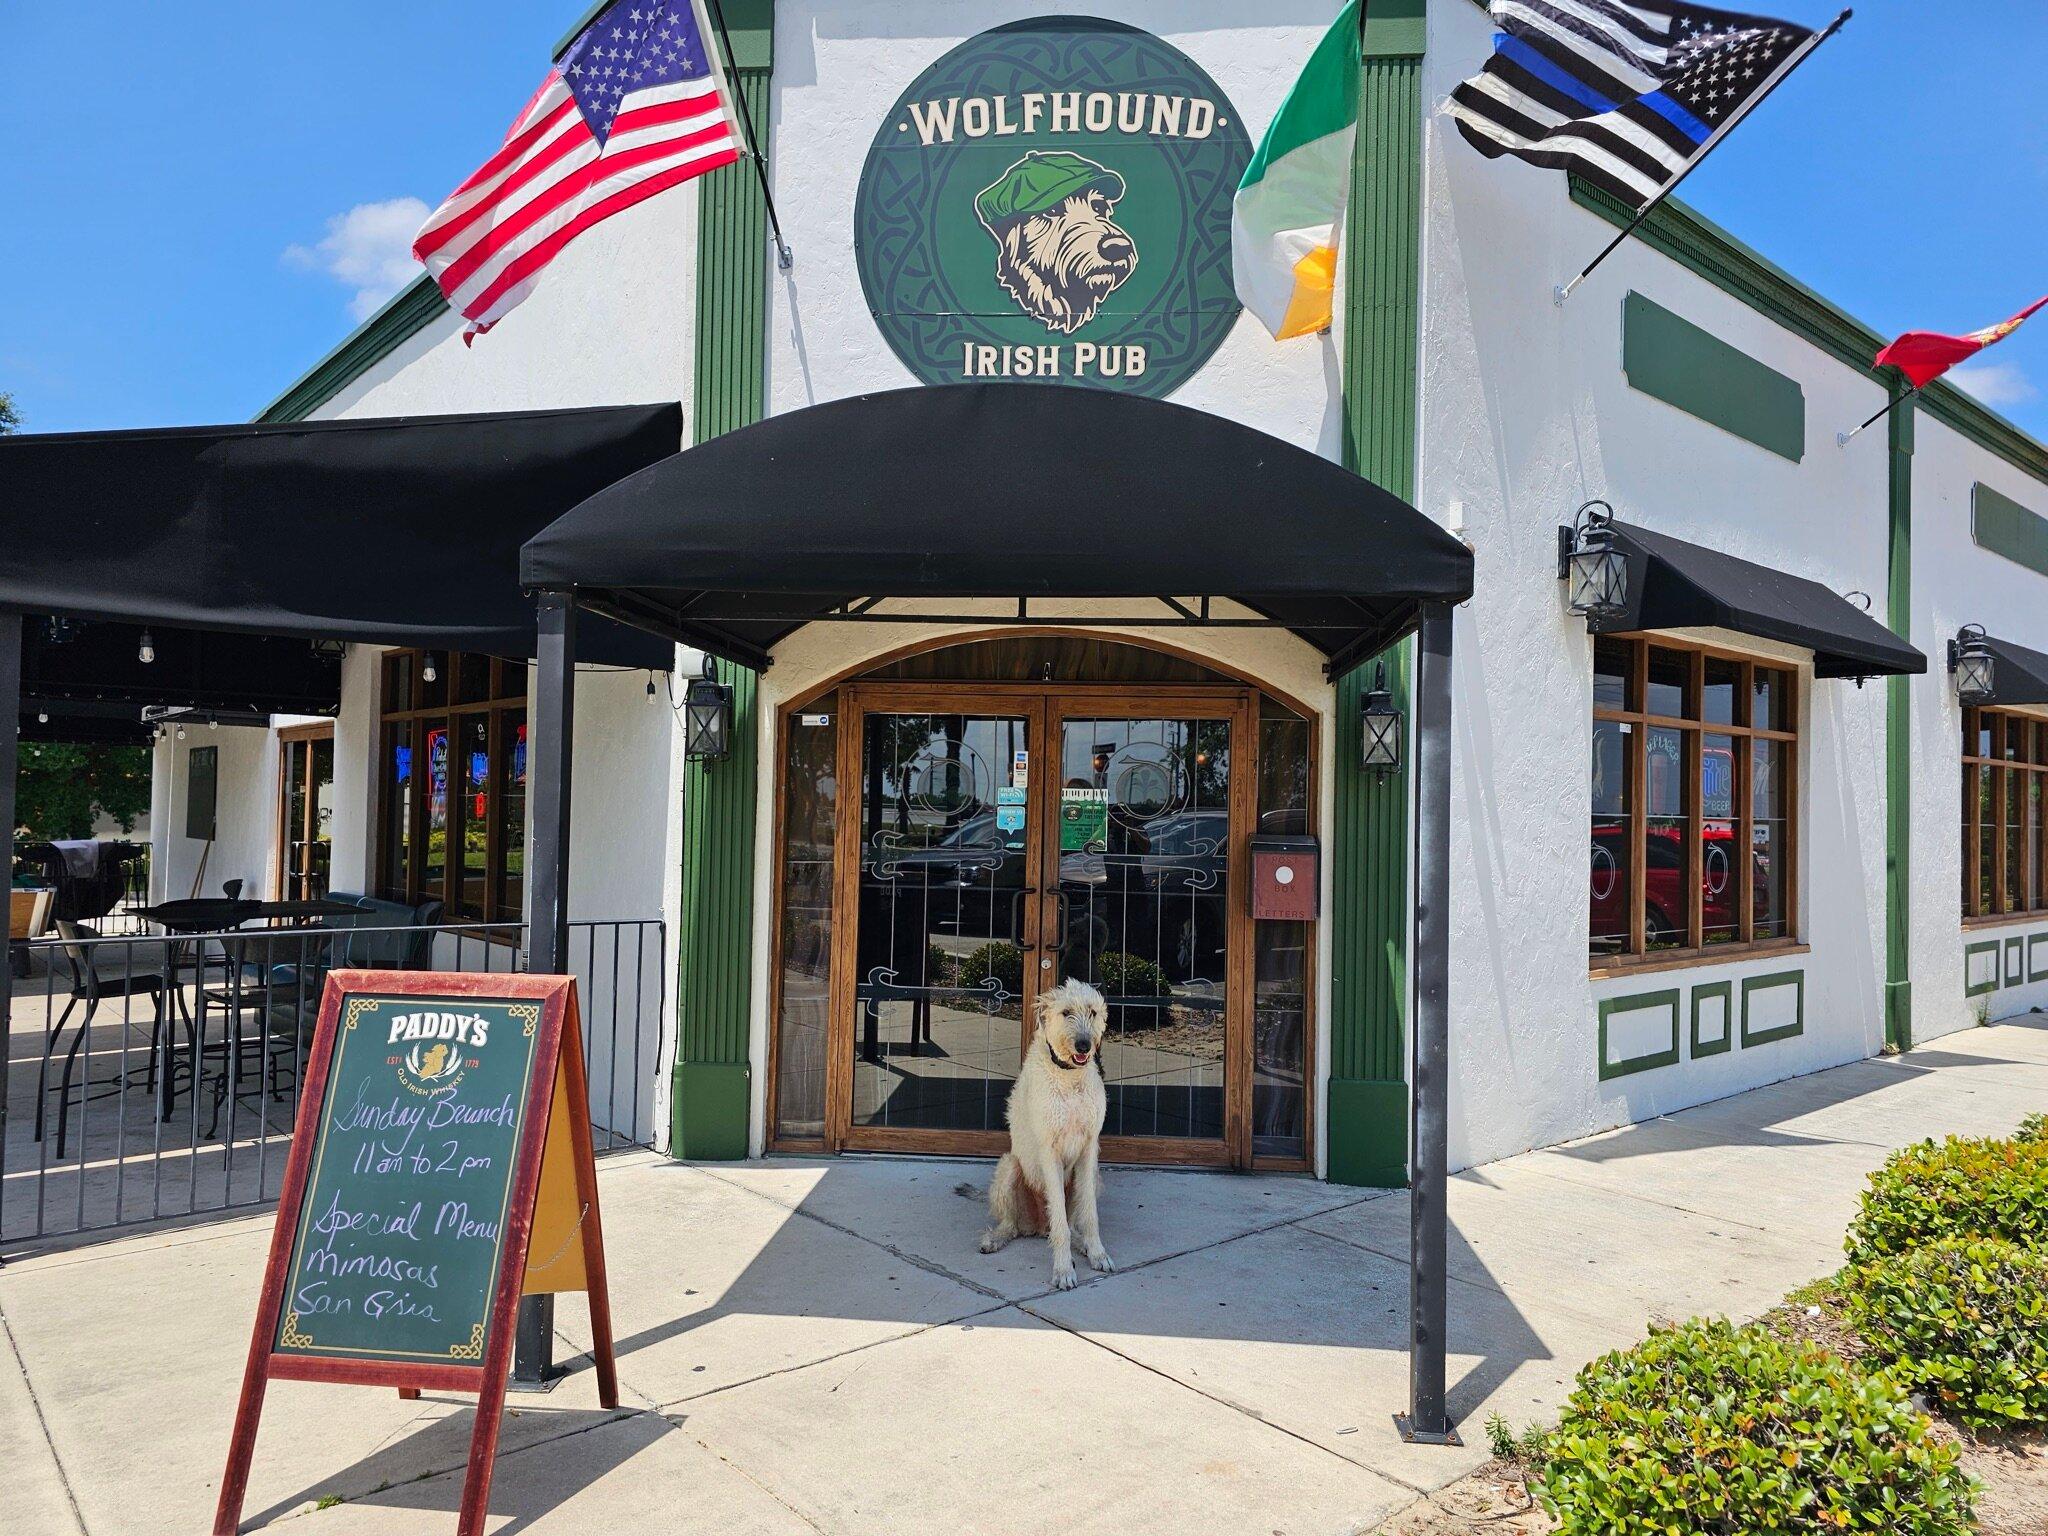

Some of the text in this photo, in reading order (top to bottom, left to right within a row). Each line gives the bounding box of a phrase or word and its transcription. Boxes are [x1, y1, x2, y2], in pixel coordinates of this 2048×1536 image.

[906, 92, 1216, 146] WOLFHOUND
[962, 342, 1147, 377] IRISH PUB
[1703, 757, 1730, 797] ite
[1711, 801, 1730, 811] BEER
[1272, 856, 1298, 864] POST
[1274, 885, 1296, 893] BOX
[1258, 910, 1305, 918] LETTERS
[387, 1012, 490, 1047] PADDY'S
[397, 1068, 465, 1096] OLD IRISH WHISKEY
[333, 1076, 516, 1156] Sunday Brunch
[410, 1144, 431, 1174] to
[312, 1189, 499, 1251] Special Menu
[293, 1281, 351, 1315] San
